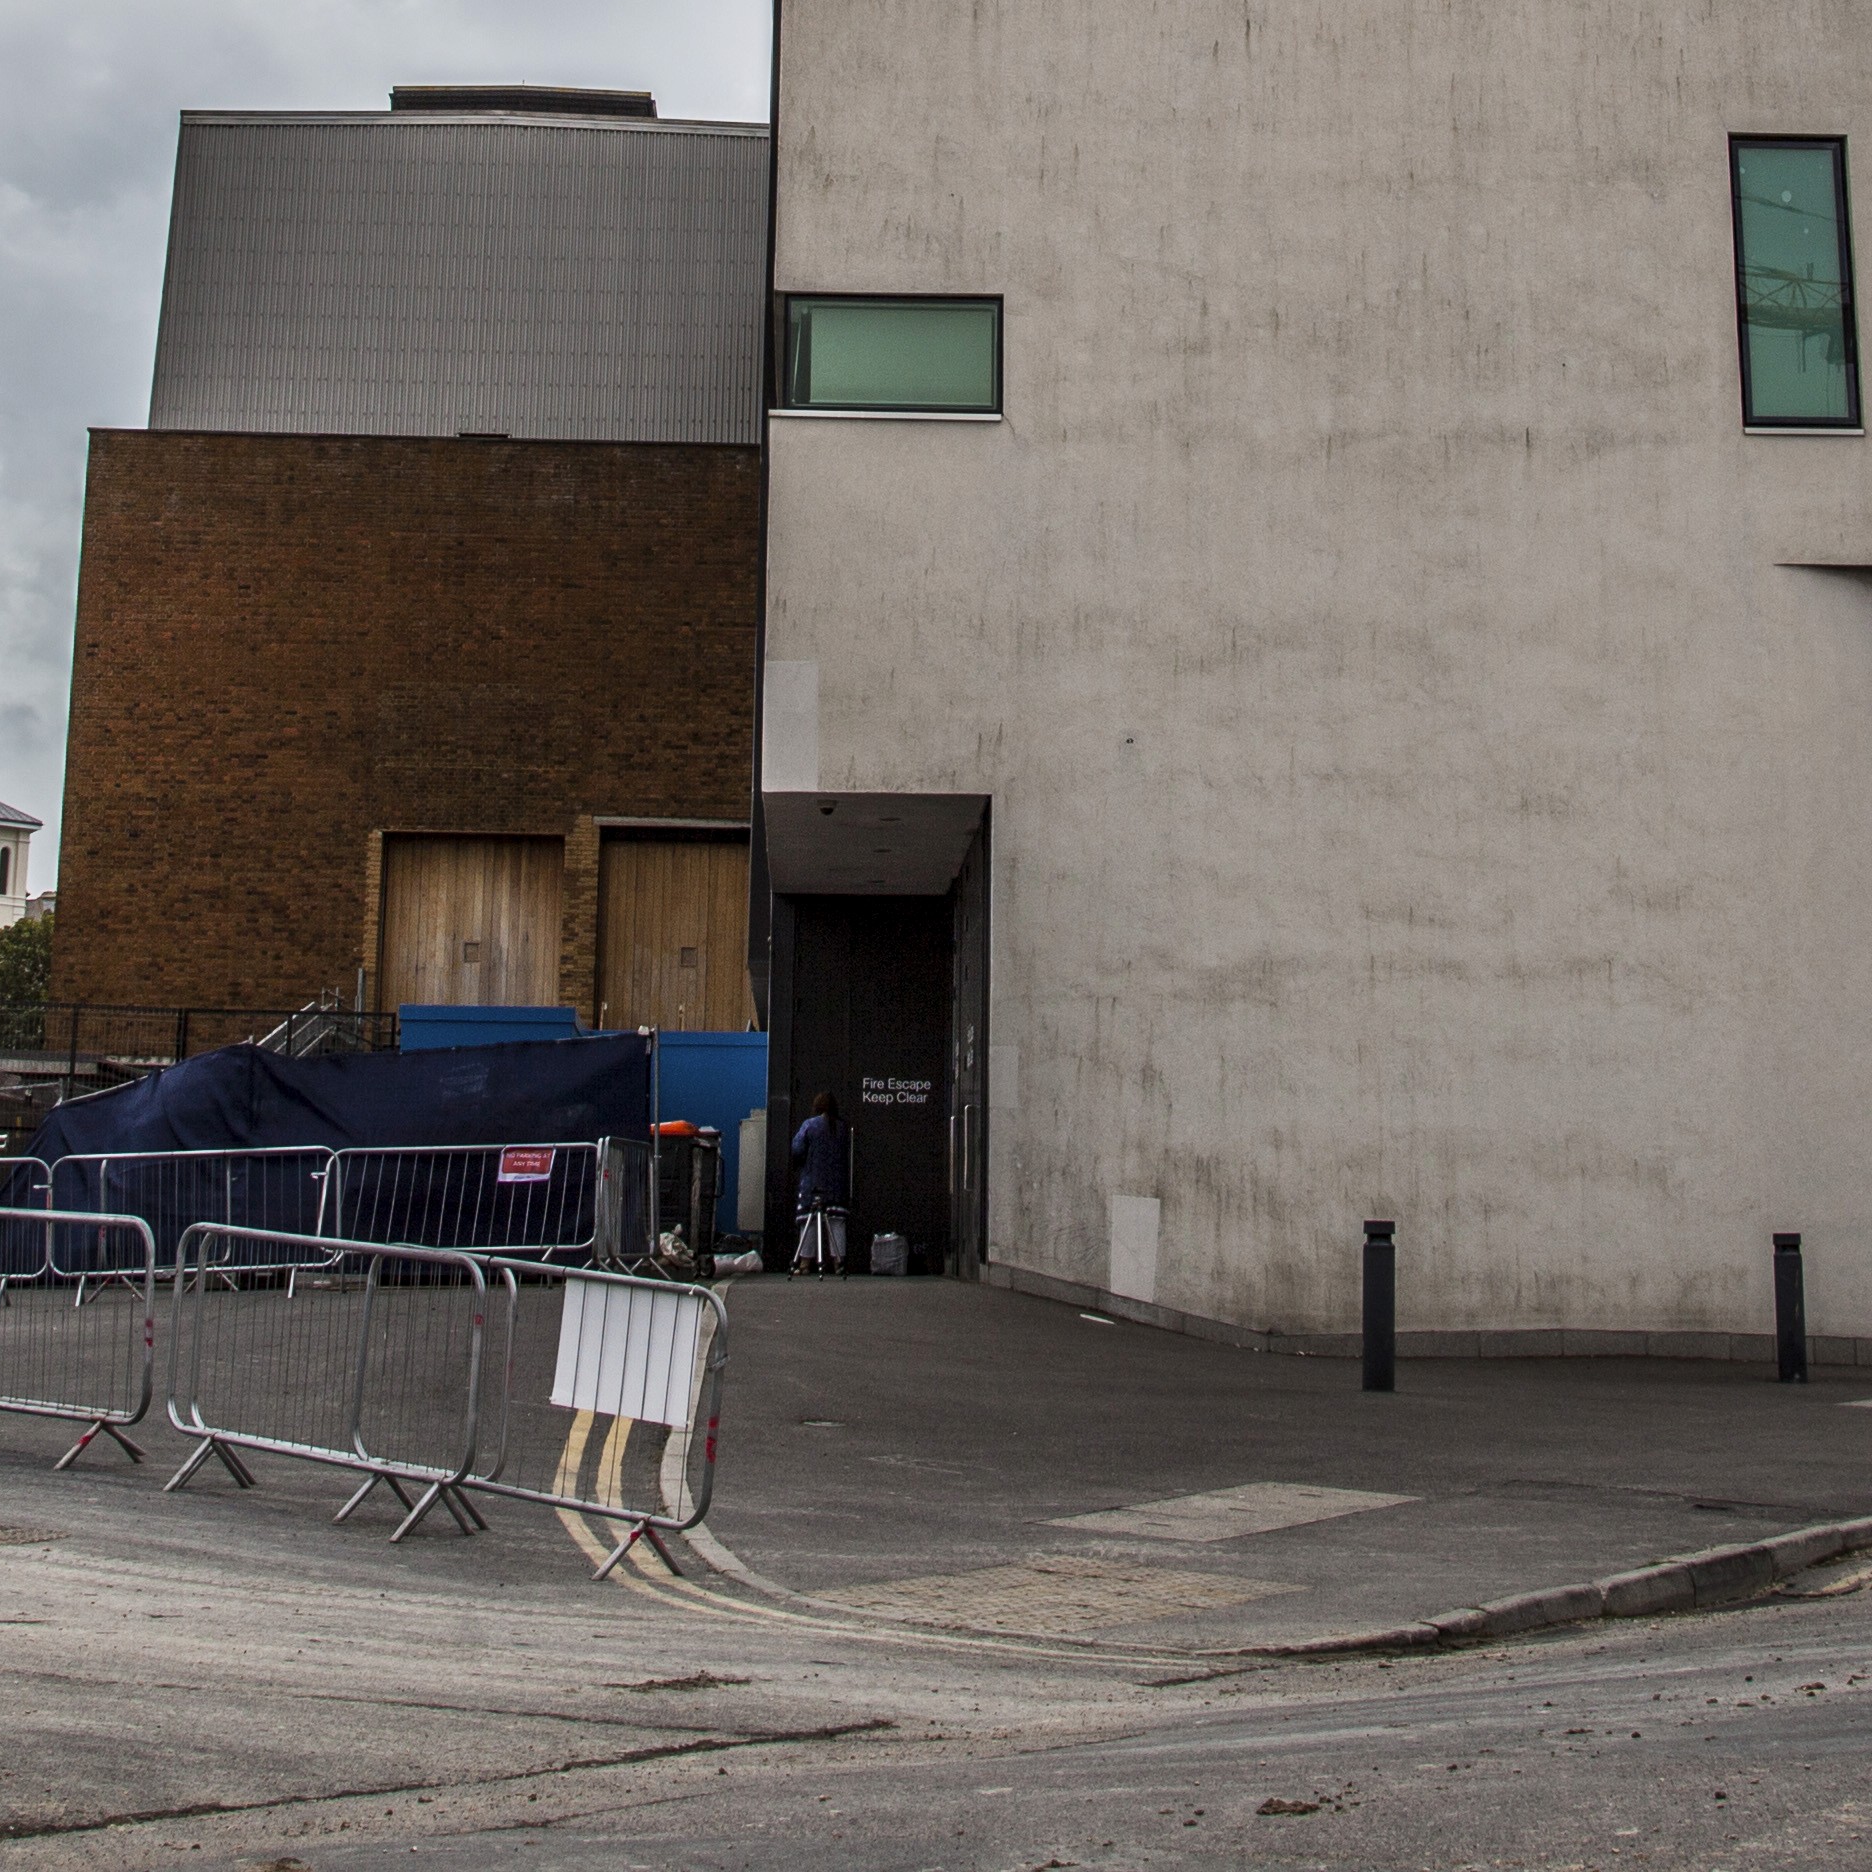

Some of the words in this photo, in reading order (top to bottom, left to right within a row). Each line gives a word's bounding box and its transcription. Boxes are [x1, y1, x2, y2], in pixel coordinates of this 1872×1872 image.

[862, 1077, 885, 1089] Fire
[887, 1077, 931, 1091] Escape
[862, 1091, 894, 1105] Keep
[896, 1091, 929, 1103] Clear
